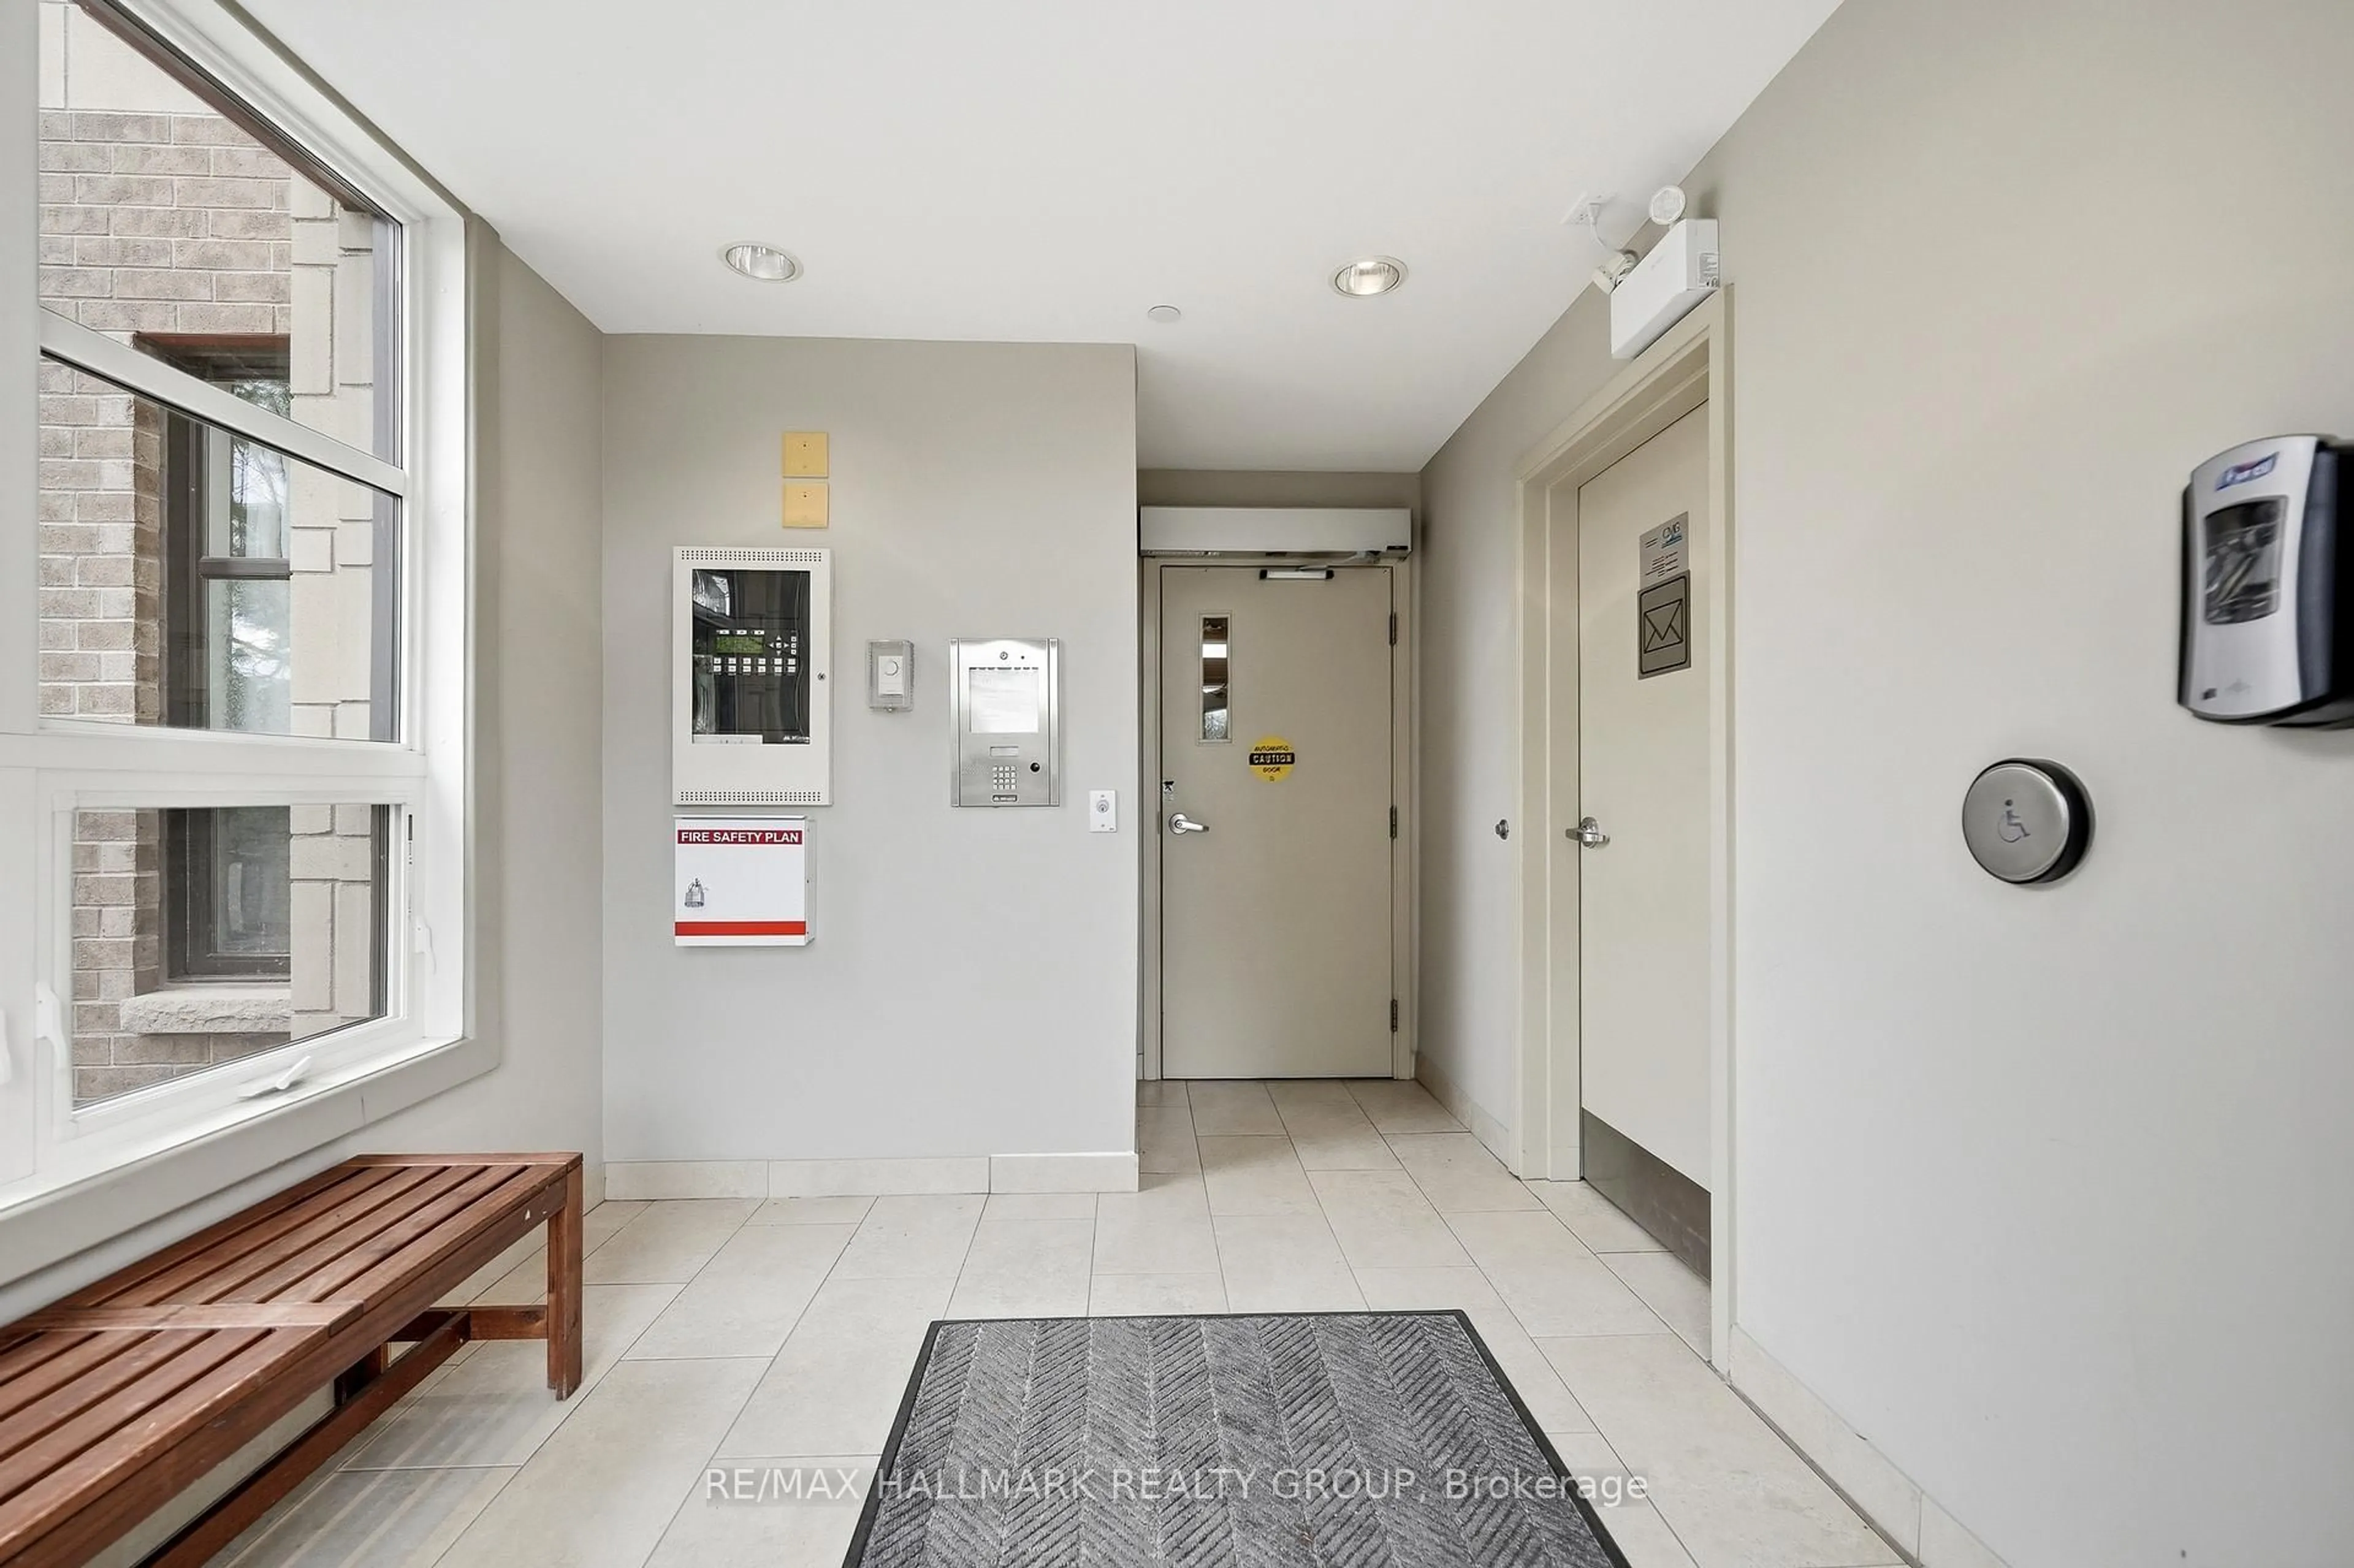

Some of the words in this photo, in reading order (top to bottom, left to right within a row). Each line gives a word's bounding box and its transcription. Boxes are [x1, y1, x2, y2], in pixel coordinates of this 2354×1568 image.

[1252, 754, 1292, 764] CAUTION
[681, 831, 710, 842] FIRE
[713, 832, 763, 843] SAFETY
[764, 832, 799, 843] PLAN
